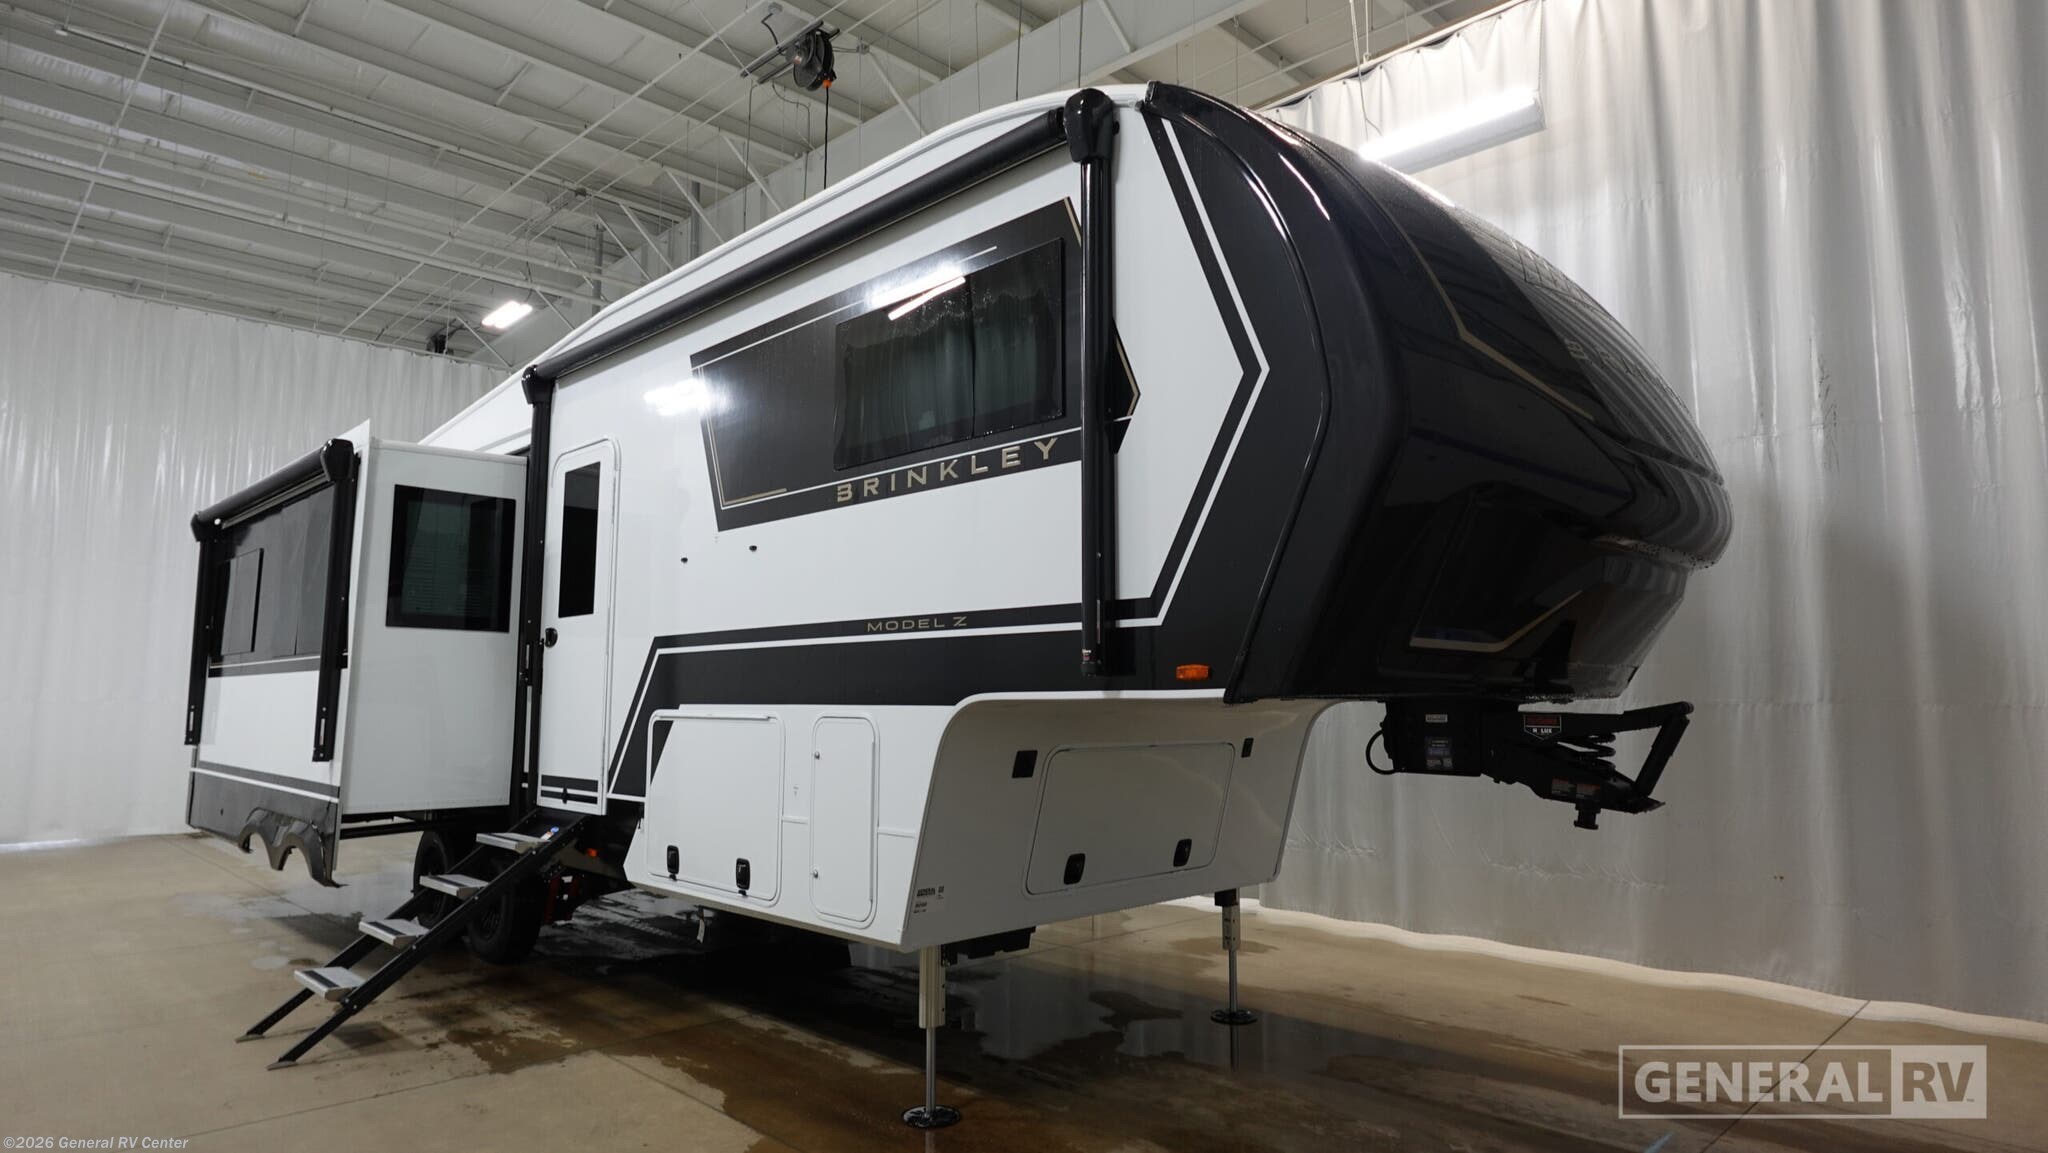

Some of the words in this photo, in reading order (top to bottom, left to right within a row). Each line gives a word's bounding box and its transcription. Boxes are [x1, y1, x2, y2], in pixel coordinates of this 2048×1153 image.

[837, 438, 1057, 502] BRINKLEY
[867, 618, 945, 632] MODEL
[953, 616, 967, 627] Z
